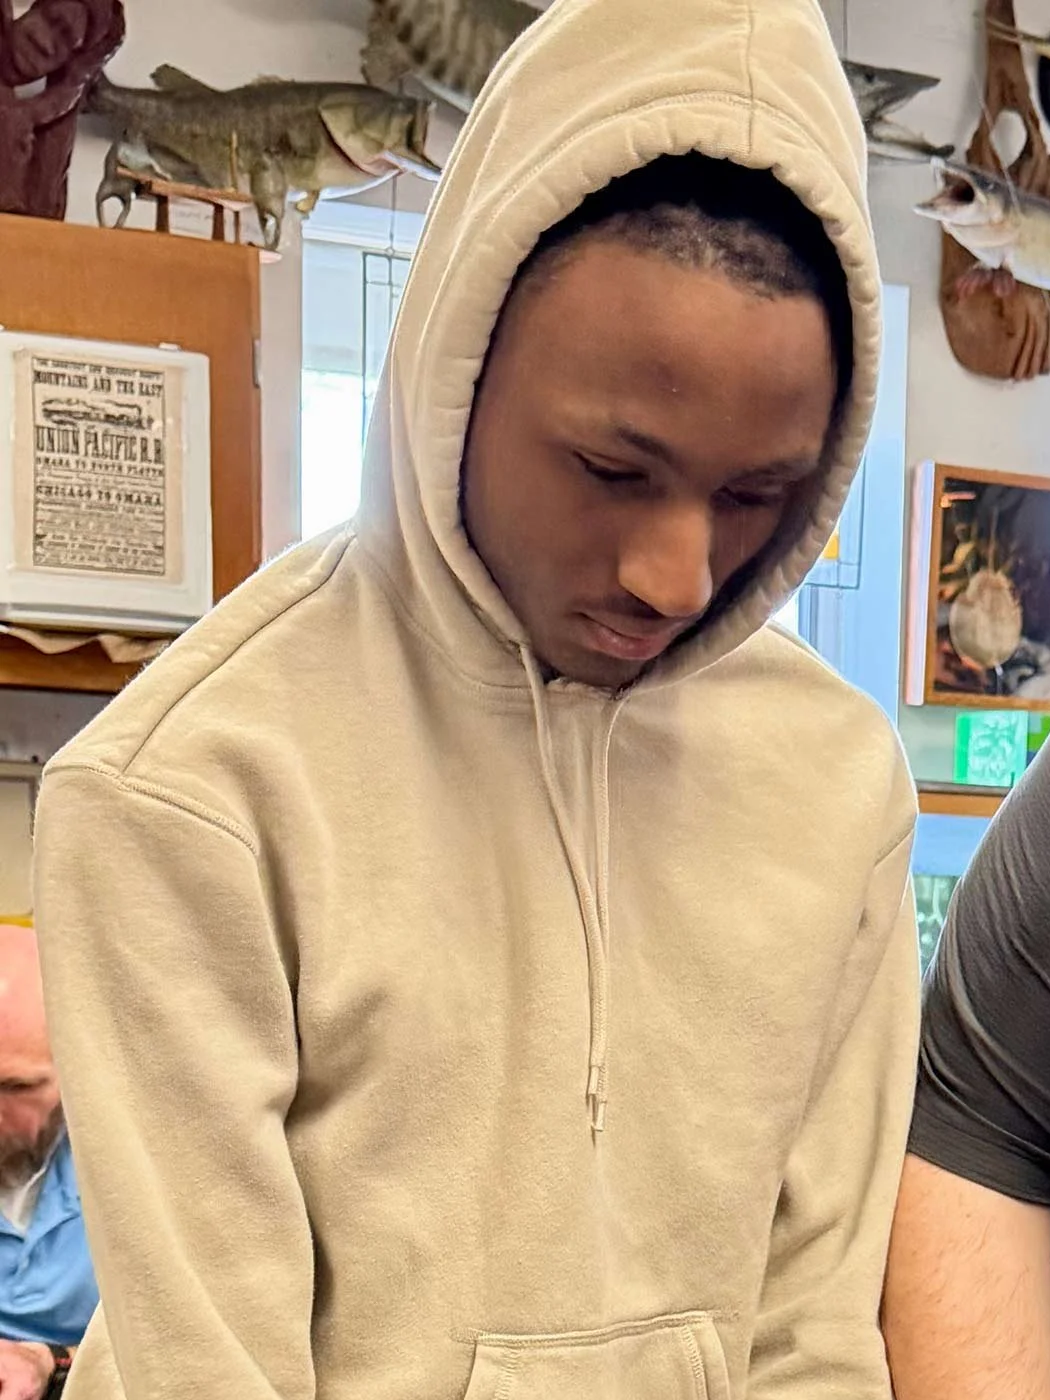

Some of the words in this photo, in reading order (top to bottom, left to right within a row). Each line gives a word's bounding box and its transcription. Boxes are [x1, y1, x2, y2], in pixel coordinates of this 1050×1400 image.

[93, 377, 111, 393] AND
[116, 380, 134, 395] THE
[35, 425, 80, 455] UNION
[84, 430, 137, 461] PACIFIC
[36, 485, 92, 499] CHICAGO
[98, 490, 112, 502] TO
[116, 493, 161, 505] OMAHA
